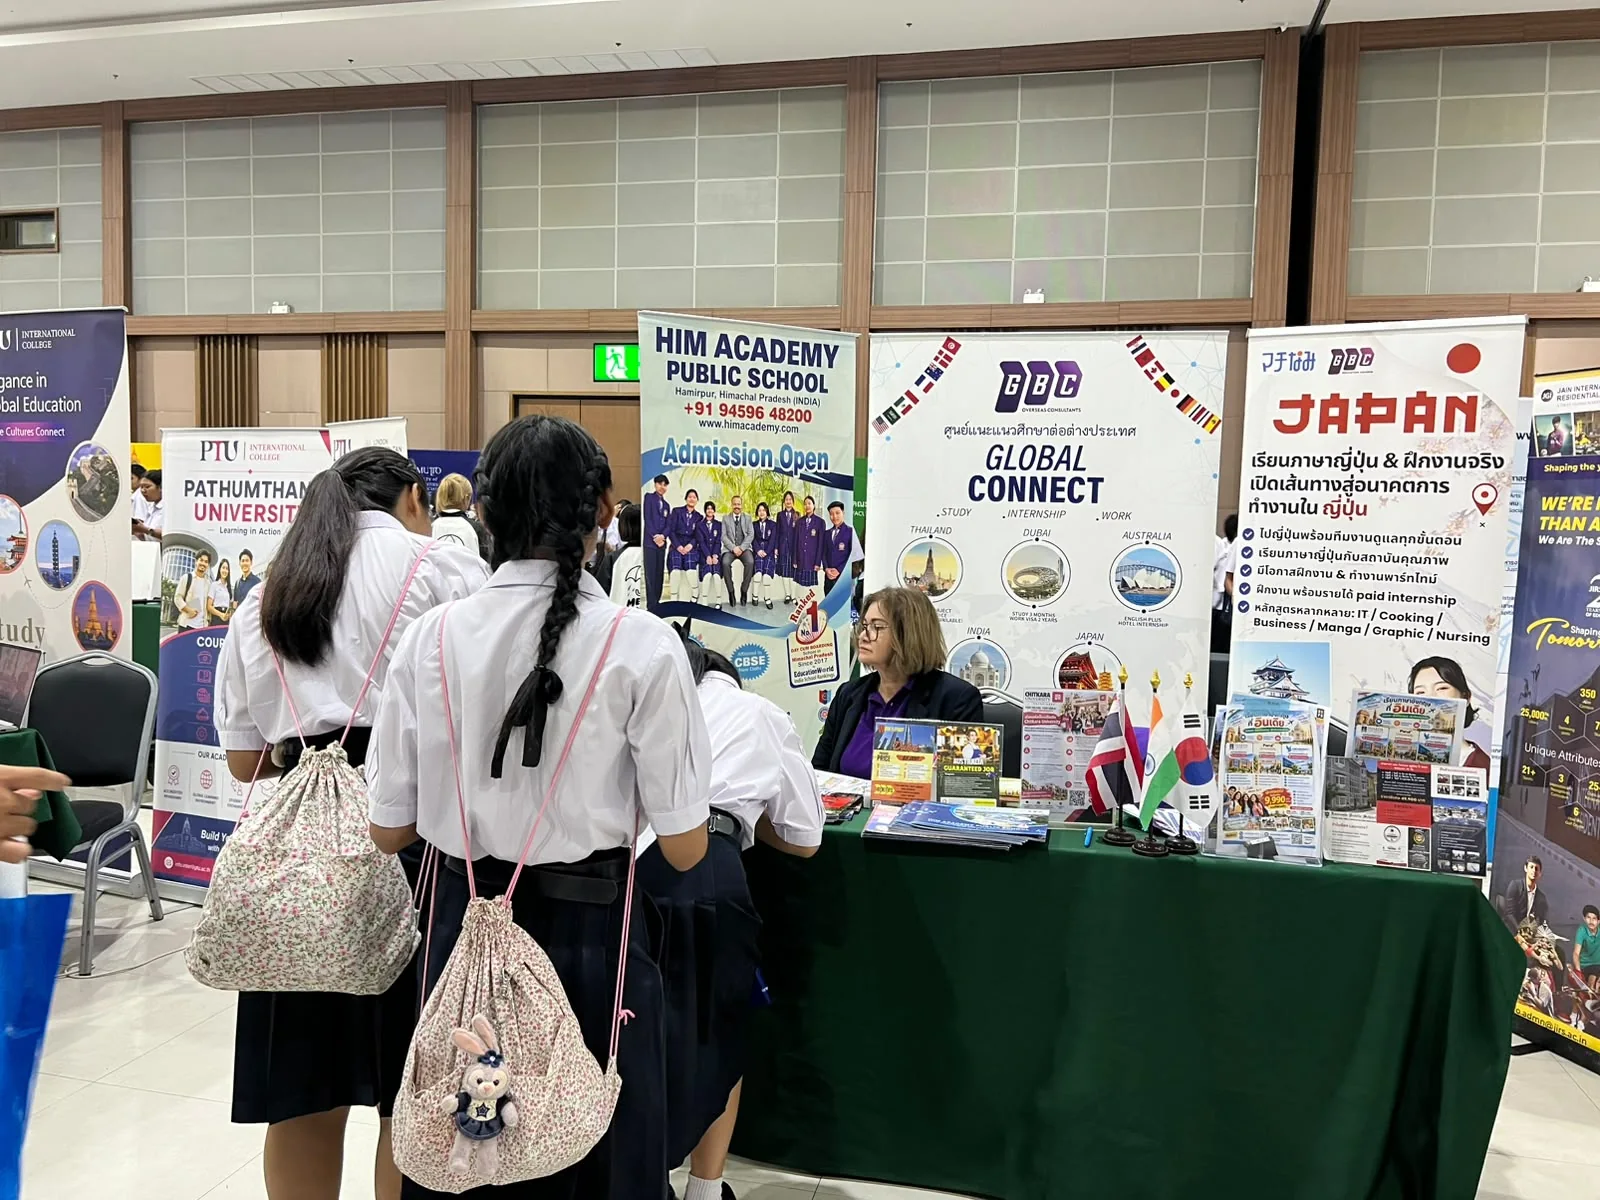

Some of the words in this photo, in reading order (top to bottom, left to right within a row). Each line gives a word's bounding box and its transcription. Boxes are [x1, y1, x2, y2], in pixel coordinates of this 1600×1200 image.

[22, 329, 76, 338] INTERNATIONAL
[22, 341, 52, 350] COLLEGE
[656, 327, 706, 357] HIM
[714, 333, 839, 368] ACADEMY
[36, 371, 48, 388] in
[667, 361, 741, 386] PUBLIC
[748, 368, 828, 394] SCHOOL
[23, 396, 82, 412] Education
[675, 387, 717, 400] Hamirpur,
[719, 391, 757, 401] Himachal
[759, 394, 792, 404] Pradesh
[793, 396, 820, 408] (INDIA)
[684, 402, 713, 416] +91
[719, 403, 764, 419] 94596
[769, 407, 812, 422] 48200
[1273, 391, 1478, 434] JAPAN
[6, 426, 34, 436] Cultures
[36, 426, 66, 436] Connect
[698, 420, 799, 434] www.himacademy.com
[944, 421, 1136, 440] ศูนย์แนะแนวศึกษาต่อต่างประเทศ
[200, 440, 238, 462] PTU
[250, 444, 306, 452] INTERNATIONAL
[662, 438, 773, 466] Admission
[780, 444, 829, 474] Open
[986, 444, 1086, 472] GLOBAL
[1252, 447, 1378, 473] เรียนภาษาญี่ปุ่น
[1383, 453, 1398, 468] &
[1403, 450, 1504, 470] ฝึกงานจริง
[1544, 464, 1578, 473] Shaping
[968, 475, 1104, 504] CONNECT
[1250, 474, 1450, 498] เปิดเส้นทางสู่อนาคตการ
[1248, 498, 1318, 516] ทำงานใน
[1322, 493, 1368, 520] ญี่ปุ่น
[1542, 496, 1594, 511] WE'RE
[194, 502, 302, 523] UNIVERSIT
[220, 526, 248, 536] Learning
[258, 528, 281, 536] Action
[910, 526, 952, 535] THAILAND
[1540, 516, 1587, 532] THAN
[1023, 528, 1051, 538] DUBAI
[1122, 531, 1172, 541] AUSTRALIA
[1260, 526, 1462, 546] ไปญี่ปุ่นพร้อมทีมงานดูแลทุกขั้นตอน
[1539, 535, 1554, 544] We
[1556, 536, 1573, 544] Are
[1576, 536, 1594, 546] The
[1258, 546, 1449, 566] เรียนภาษาญี่ปุ่นกับสถาบันคุณภาพ
[1257, 565, 1332, 578] มีโอกาสฝึกงาน
[1336, 570, 1346, 579] &
[1349, 569, 1438, 584] ทำงานพาร์ทไทม์
[1256, 584, 1290, 595] ฝึกงาน
[1293, 586, 1354, 599] พร้อมรายได้
[1356, 591, 1384, 602] paid
[1388, 592, 1456, 608] internship
[790, 588, 816, 623] Ranked
[806, 601, 818, 632] 1
[1254, 602, 1354, 618] หลักสูตรหลากหลาย:
[1358, 610, 1368, 619] IT
[1370, 608, 1377, 622] /
[1380, 611, 1434, 626] Cooking
[1436, 612, 1444, 626] /
[967, 627, 990, 635] INDIA
[1075, 632, 1104, 640] JAPAN
[1254, 618, 1306, 630] Business
[1308, 620, 1316, 632] /
[1318, 622, 1362, 636] Manga
[1364, 623, 1370, 636] /
[1372, 626, 1424, 640] Graphic
[1427, 628, 1434, 641] /
[1436, 631, 1490, 646] Nursing
[734, 656, 766, 668] CBSE
[794, 666, 834, 678] EducationWorld
[1580, 688, 1596, 699] 350
[1564, 716, 1570, 724] 4
[198, 750, 210, 759] OUR
[1525, 742, 1556, 758] Unique
[1522, 766, 1536, 776] 21+
[1558, 774, 1564, 783] 3
[201, 830, 220, 840] Build
